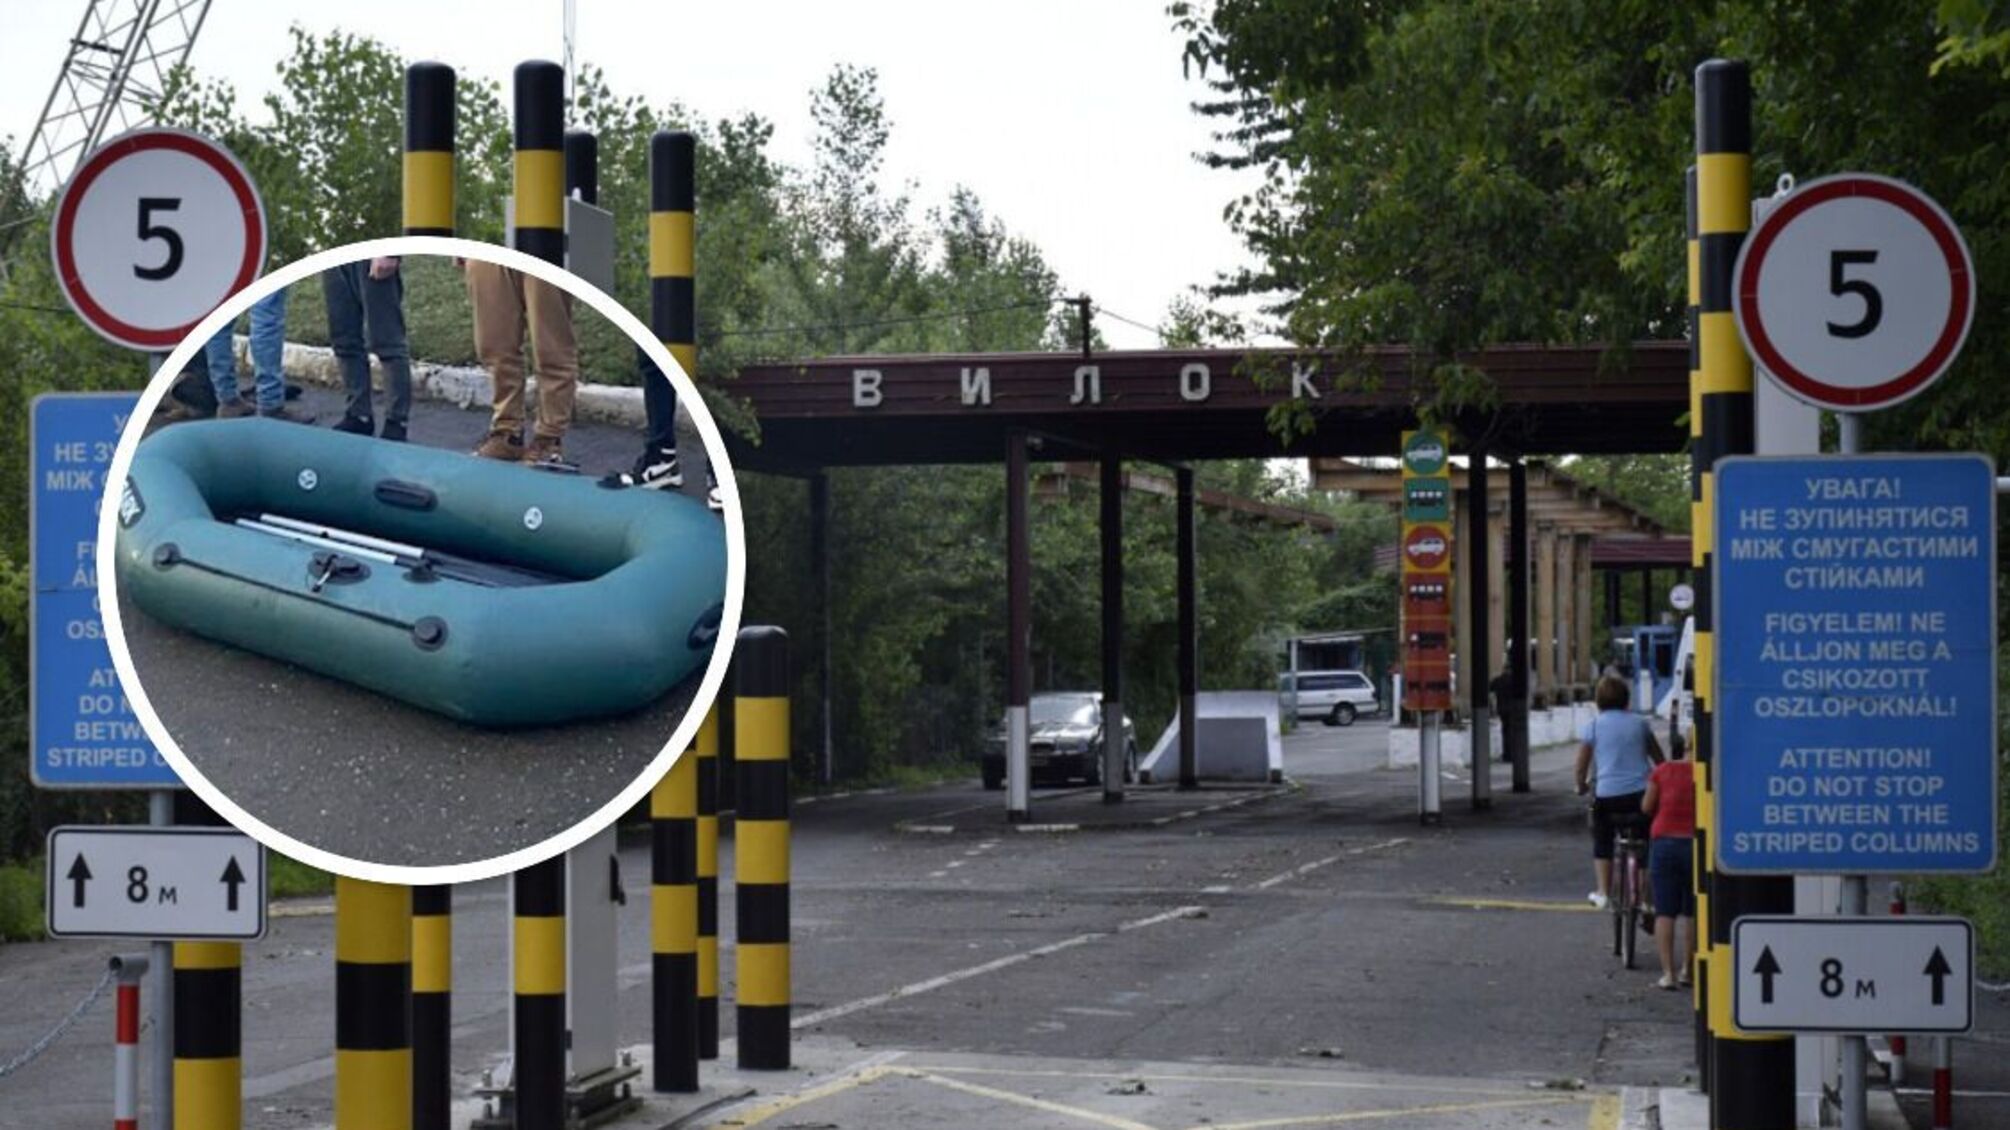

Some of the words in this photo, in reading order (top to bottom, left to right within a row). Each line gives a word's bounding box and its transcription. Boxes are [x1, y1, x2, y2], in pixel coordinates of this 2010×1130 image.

[133, 197, 185, 281] 5
[1826, 250, 1883, 338] 5
[55, 442, 86, 463] НЕ
[46, 470, 94, 491] МІЖ
[1804, 477, 1901, 500] УВАГА!
[1740, 508, 1776, 530] НЕ
[1784, 506, 1969, 530] ЗУПИНЯТИСЯ
[1731, 538, 1784, 560] МІЖ
[1792, 537, 1978, 559] СМУГАСТИМИ
[1785, 563, 1924, 589] СТІЙКАМИ
[1765, 613, 1903, 634] FIGYELEM!
[1911, 612, 1945, 633] NE
[1759, 637, 1861, 662] ÁLLJON
[1868, 641, 1927, 661] MEG
[1932, 641, 1952, 661] A
[1782, 669, 1930, 690] CSIKOZOTT
[79, 694, 114, 715] DO
[1754, 693, 1957, 718] OSZLOPOKNÁL!
[47, 746, 147, 768] STRIPED
[1779, 748, 1932, 769] ATTENTION!
[1768, 776, 1807, 797] DO
[1813, 776, 1867, 797] NOT
[1875, 776, 1944, 797] STOP
[1763, 804, 1890, 825] BETWEEN
[1898, 803, 1949, 824] THE
[1733, 832, 1843, 853] STRIPED
[1850, 832, 1979, 853] COLUMNS
[127, 865, 149, 903] 8
[1820, 958, 1844, 998] 8
